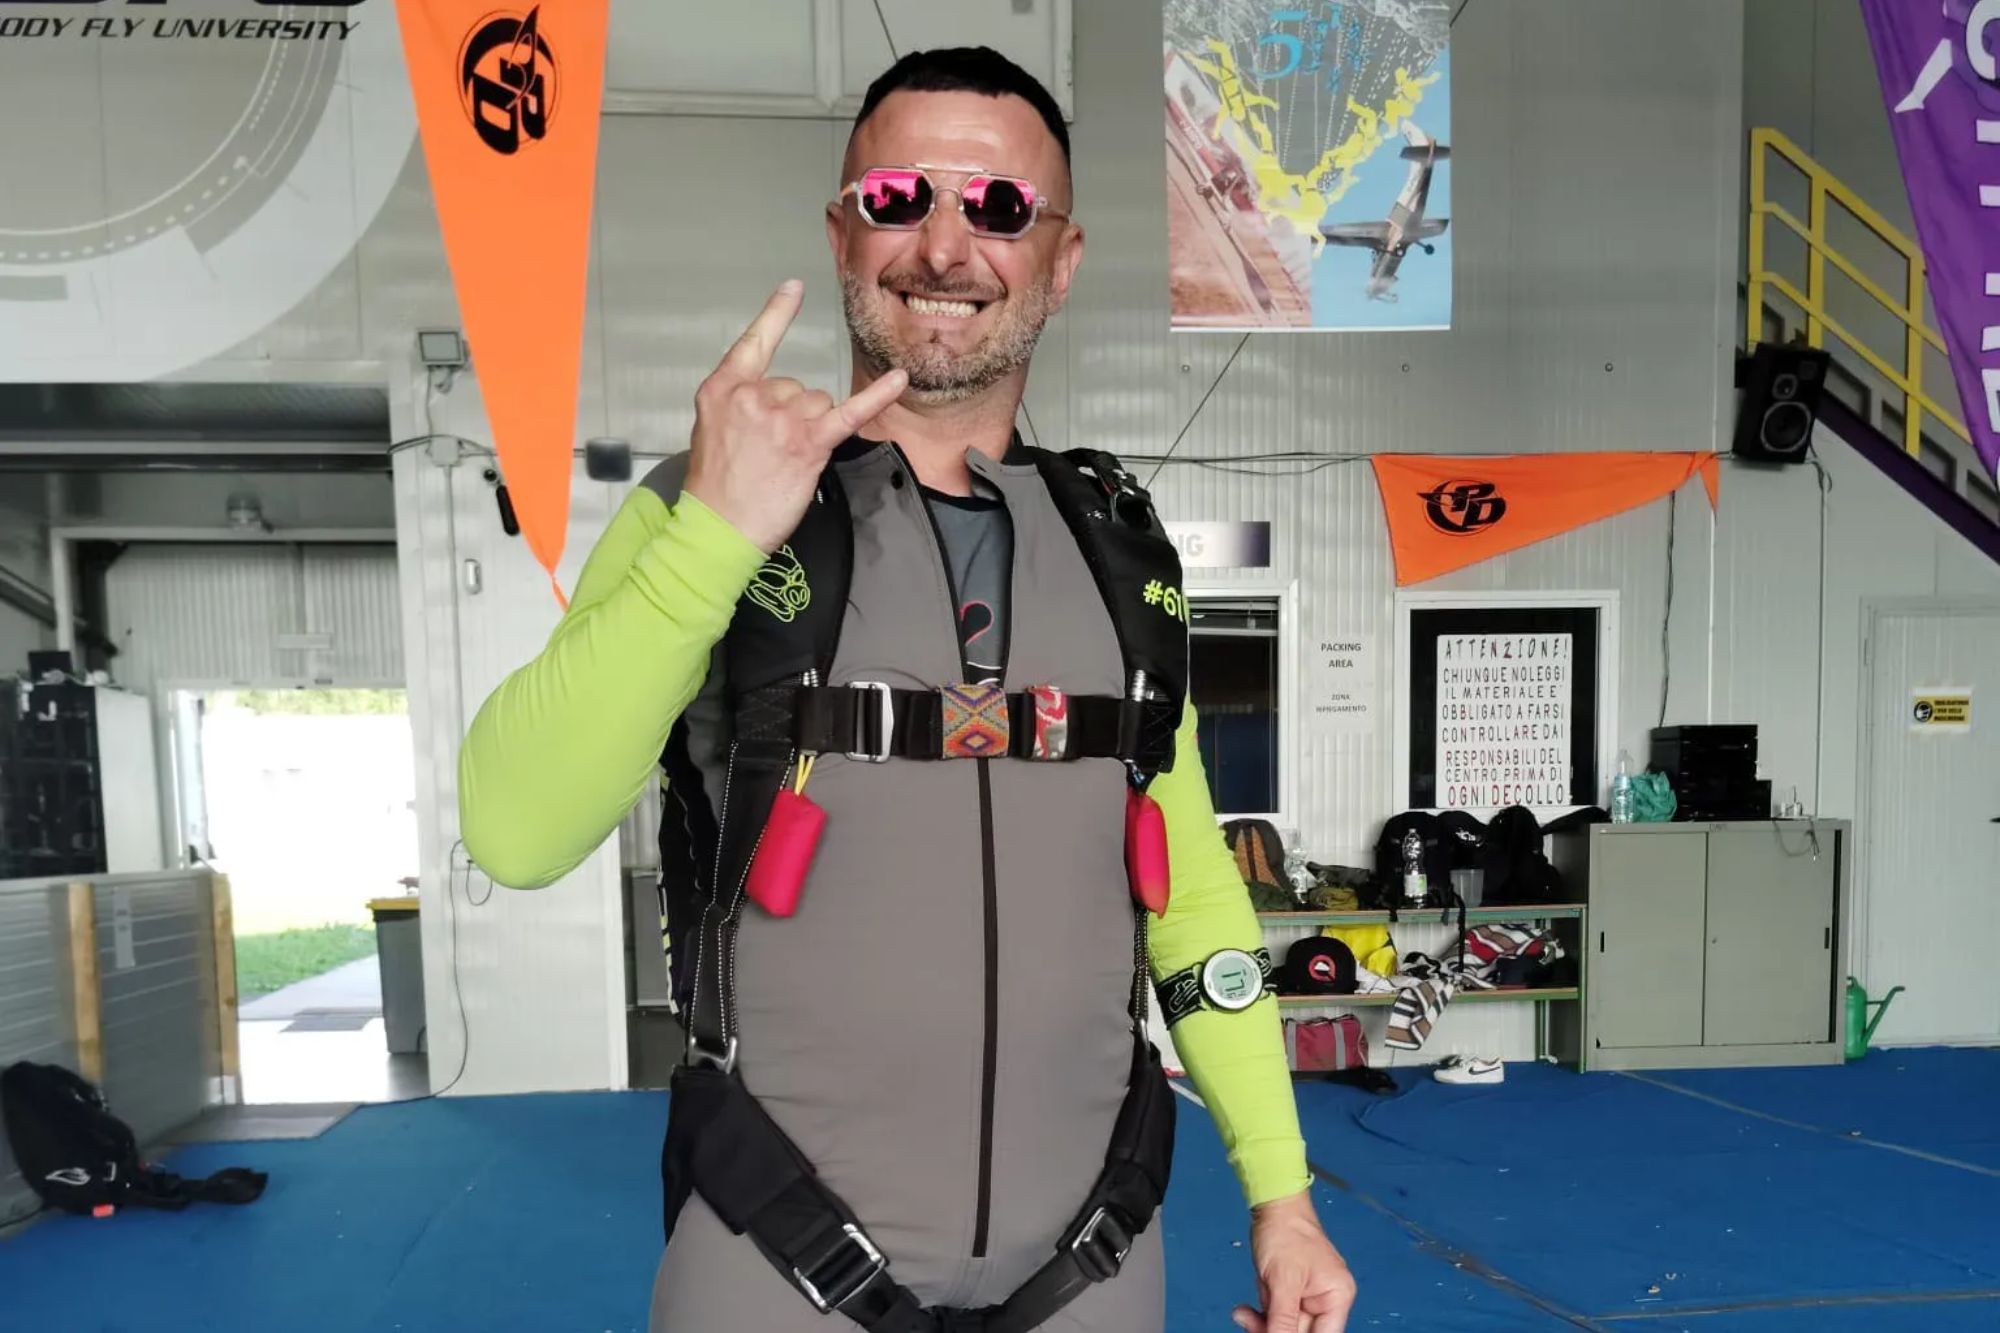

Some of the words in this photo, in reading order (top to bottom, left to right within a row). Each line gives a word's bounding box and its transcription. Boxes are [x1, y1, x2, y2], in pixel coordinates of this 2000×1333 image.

[0, 17, 74, 38] ODY
[81, 18, 145, 38] FLY
[152, 18, 361, 41] UNIVERSITY
[1321, 643, 1362, 652] PACKING
[1446, 639, 1567, 660] ATTENZIONE!
[1329, 659, 1353, 668] AREA
[1444, 668, 1507, 683] CHIUNQUE
[1512, 667, 1566, 682] NOLEGGI
[1446, 688, 1456, 699] IL
[1463, 685, 1543, 699] MATERIALE
[1443, 704, 1511, 720] OBBLIGATO
[1517, 705, 1522, 719] A
[1528, 704, 1563, 719] FARSI
[1443, 726, 1538, 743] CONTROLLARE
[1543, 725, 1563, 739] DAI
[1447, 750, 1537, 767] RESPONSABILI
[1540, 749, 1561, 764] DEL
[1447, 768, 1496, 782] CENTRO
[1504, 768, 1544, 780] PRIMA
[1551, 768, 1561, 781] DI
[1448, 786, 1485, 806] OGNI
[1492, 784, 1563, 805] DECOLLO
